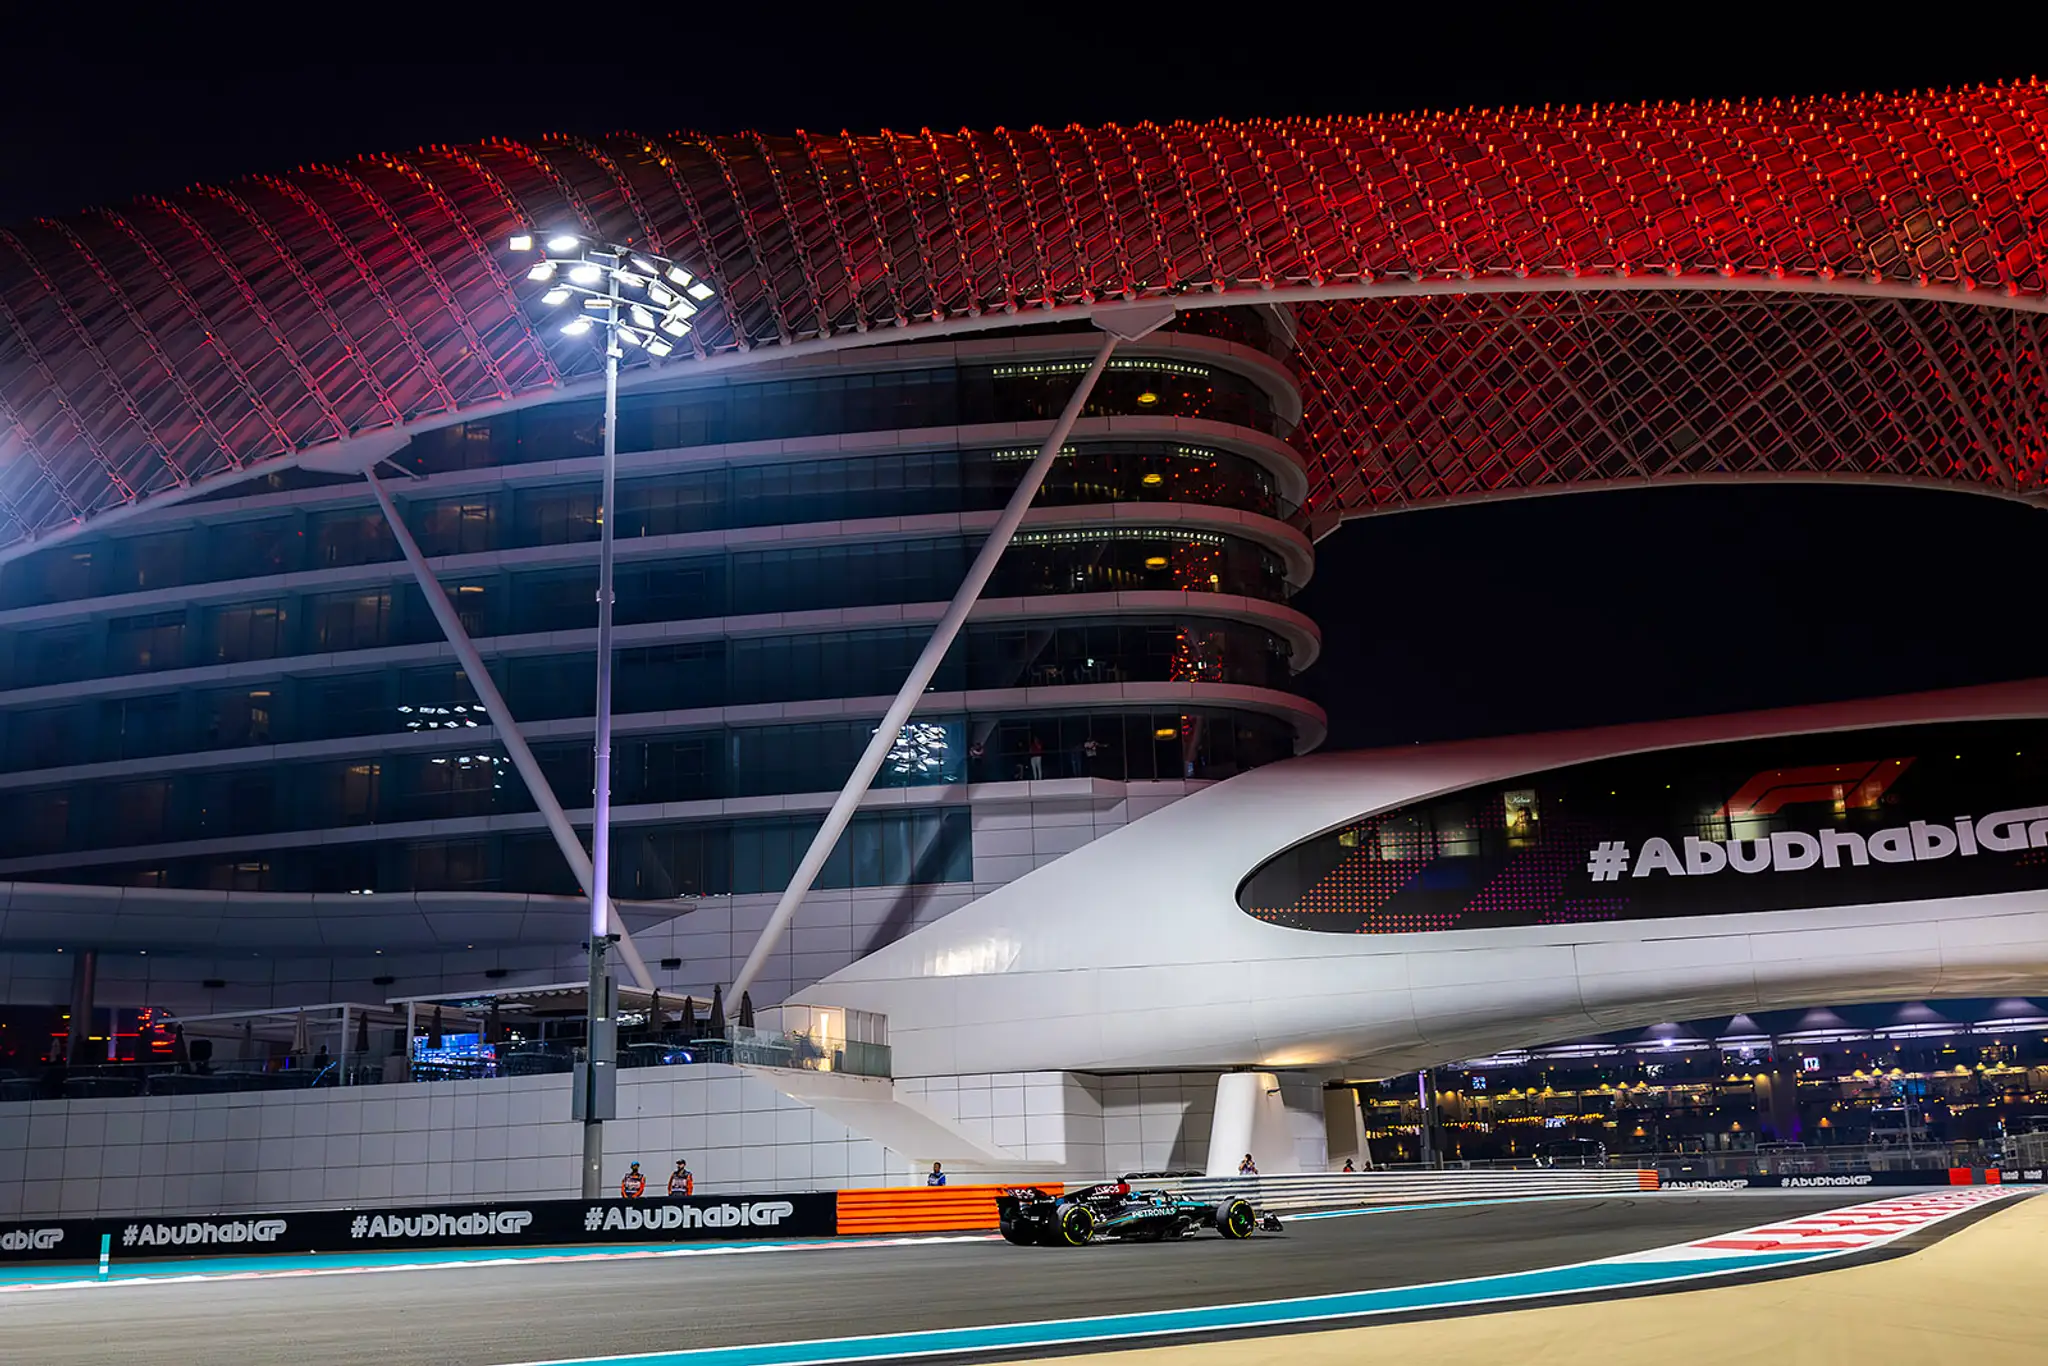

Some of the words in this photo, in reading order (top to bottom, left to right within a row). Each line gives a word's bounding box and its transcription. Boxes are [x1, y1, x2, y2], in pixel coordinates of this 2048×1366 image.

[1661, 1179, 1749, 1189] #AbuDhabiGP
[1780, 1175, 1873, 1188] #AbuDhabiGP
[351, 1210, 533, 1239] #AbuDhabiGP
[585, 1202, 794, 1231] #AbuDhabiGP
[1131, 1207, 1176, 1219] PETRONAS
[0, 1228, 64, 1251] abiGP
[123, 1219, 287, 1246] #AbuDhabiGP
